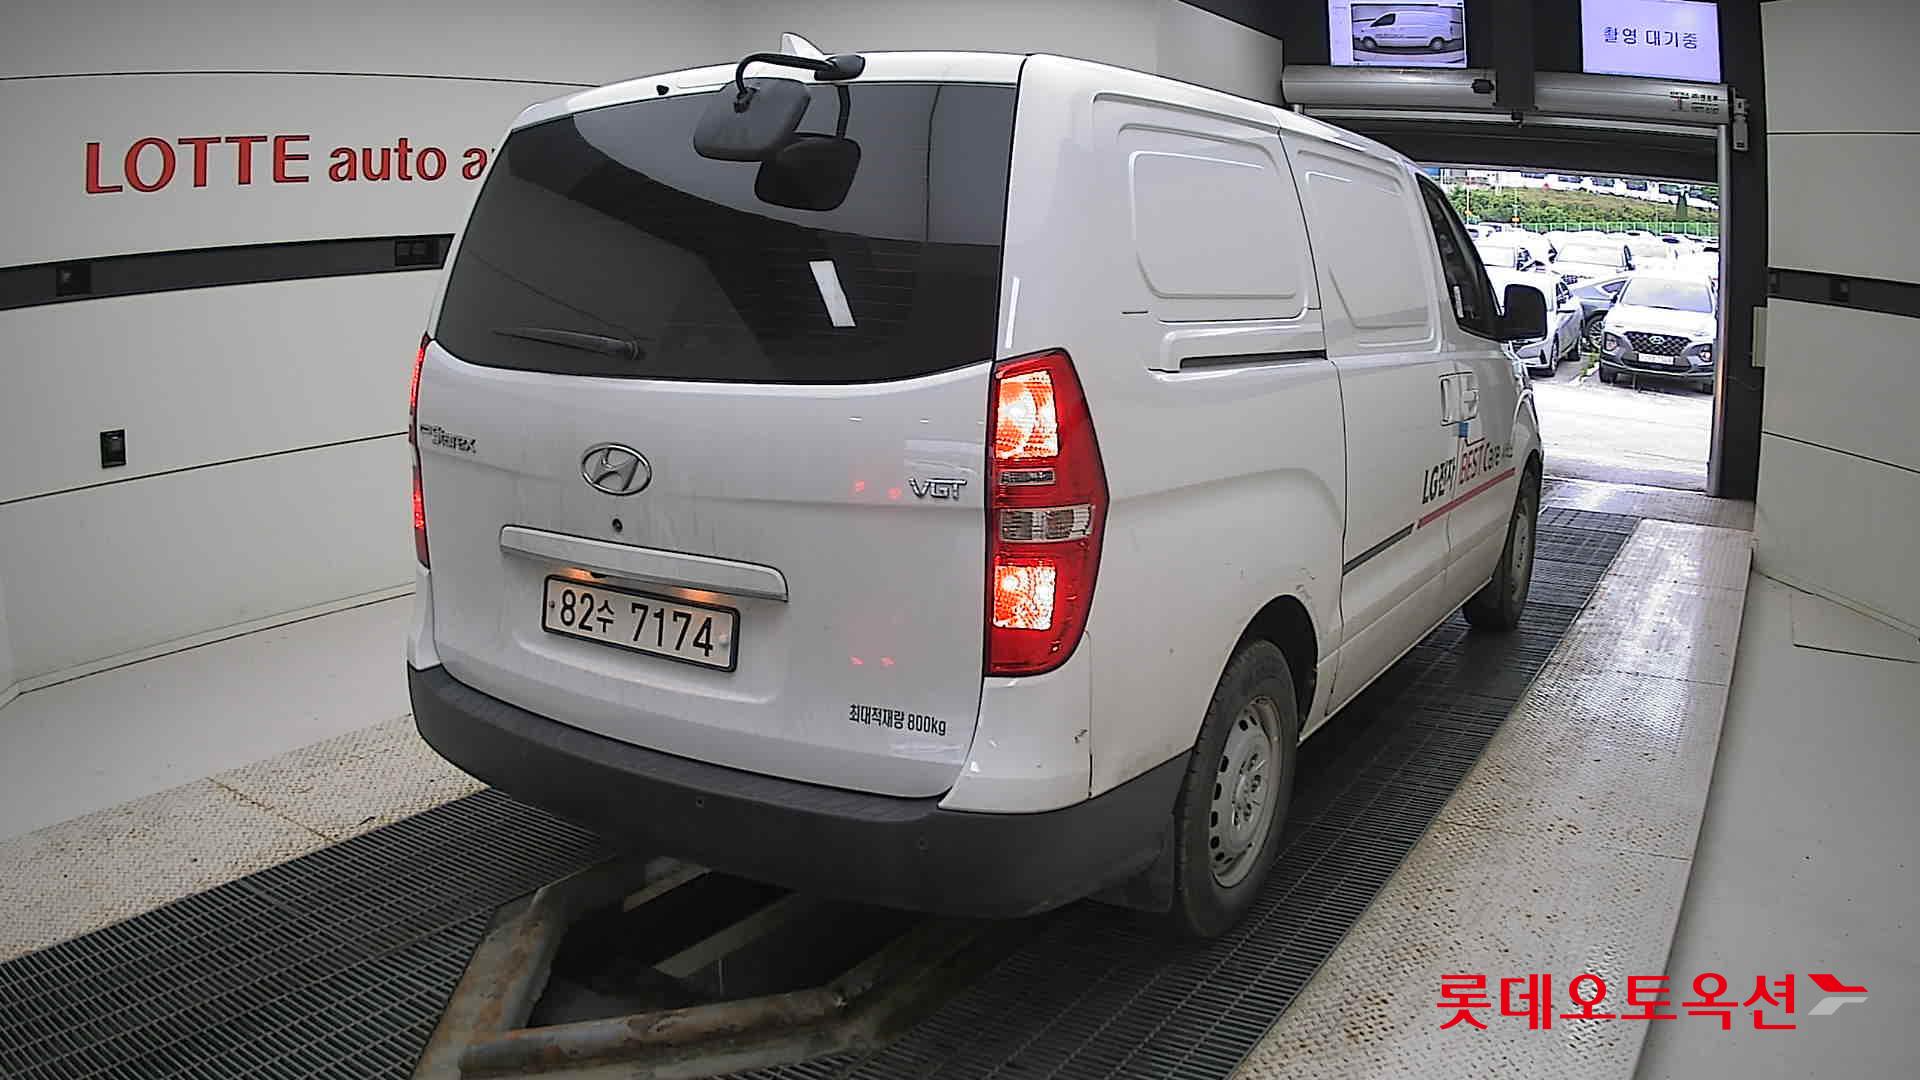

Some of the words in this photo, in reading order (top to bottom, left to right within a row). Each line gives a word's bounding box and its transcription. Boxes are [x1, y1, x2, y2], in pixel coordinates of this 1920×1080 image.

[1645, 30, 1697, 49] 대기중
[86, 135, 310, 194] LOTTE
[328, 137, 447, 182] auto
[908, 478, 967, 501] VGT
[560, 589, 615, 633] 82수
[631, 602, 713, 657] 7174
[849, 704, 905, 730] 최대적재량
[907, 713, 947, 737] 800kg
